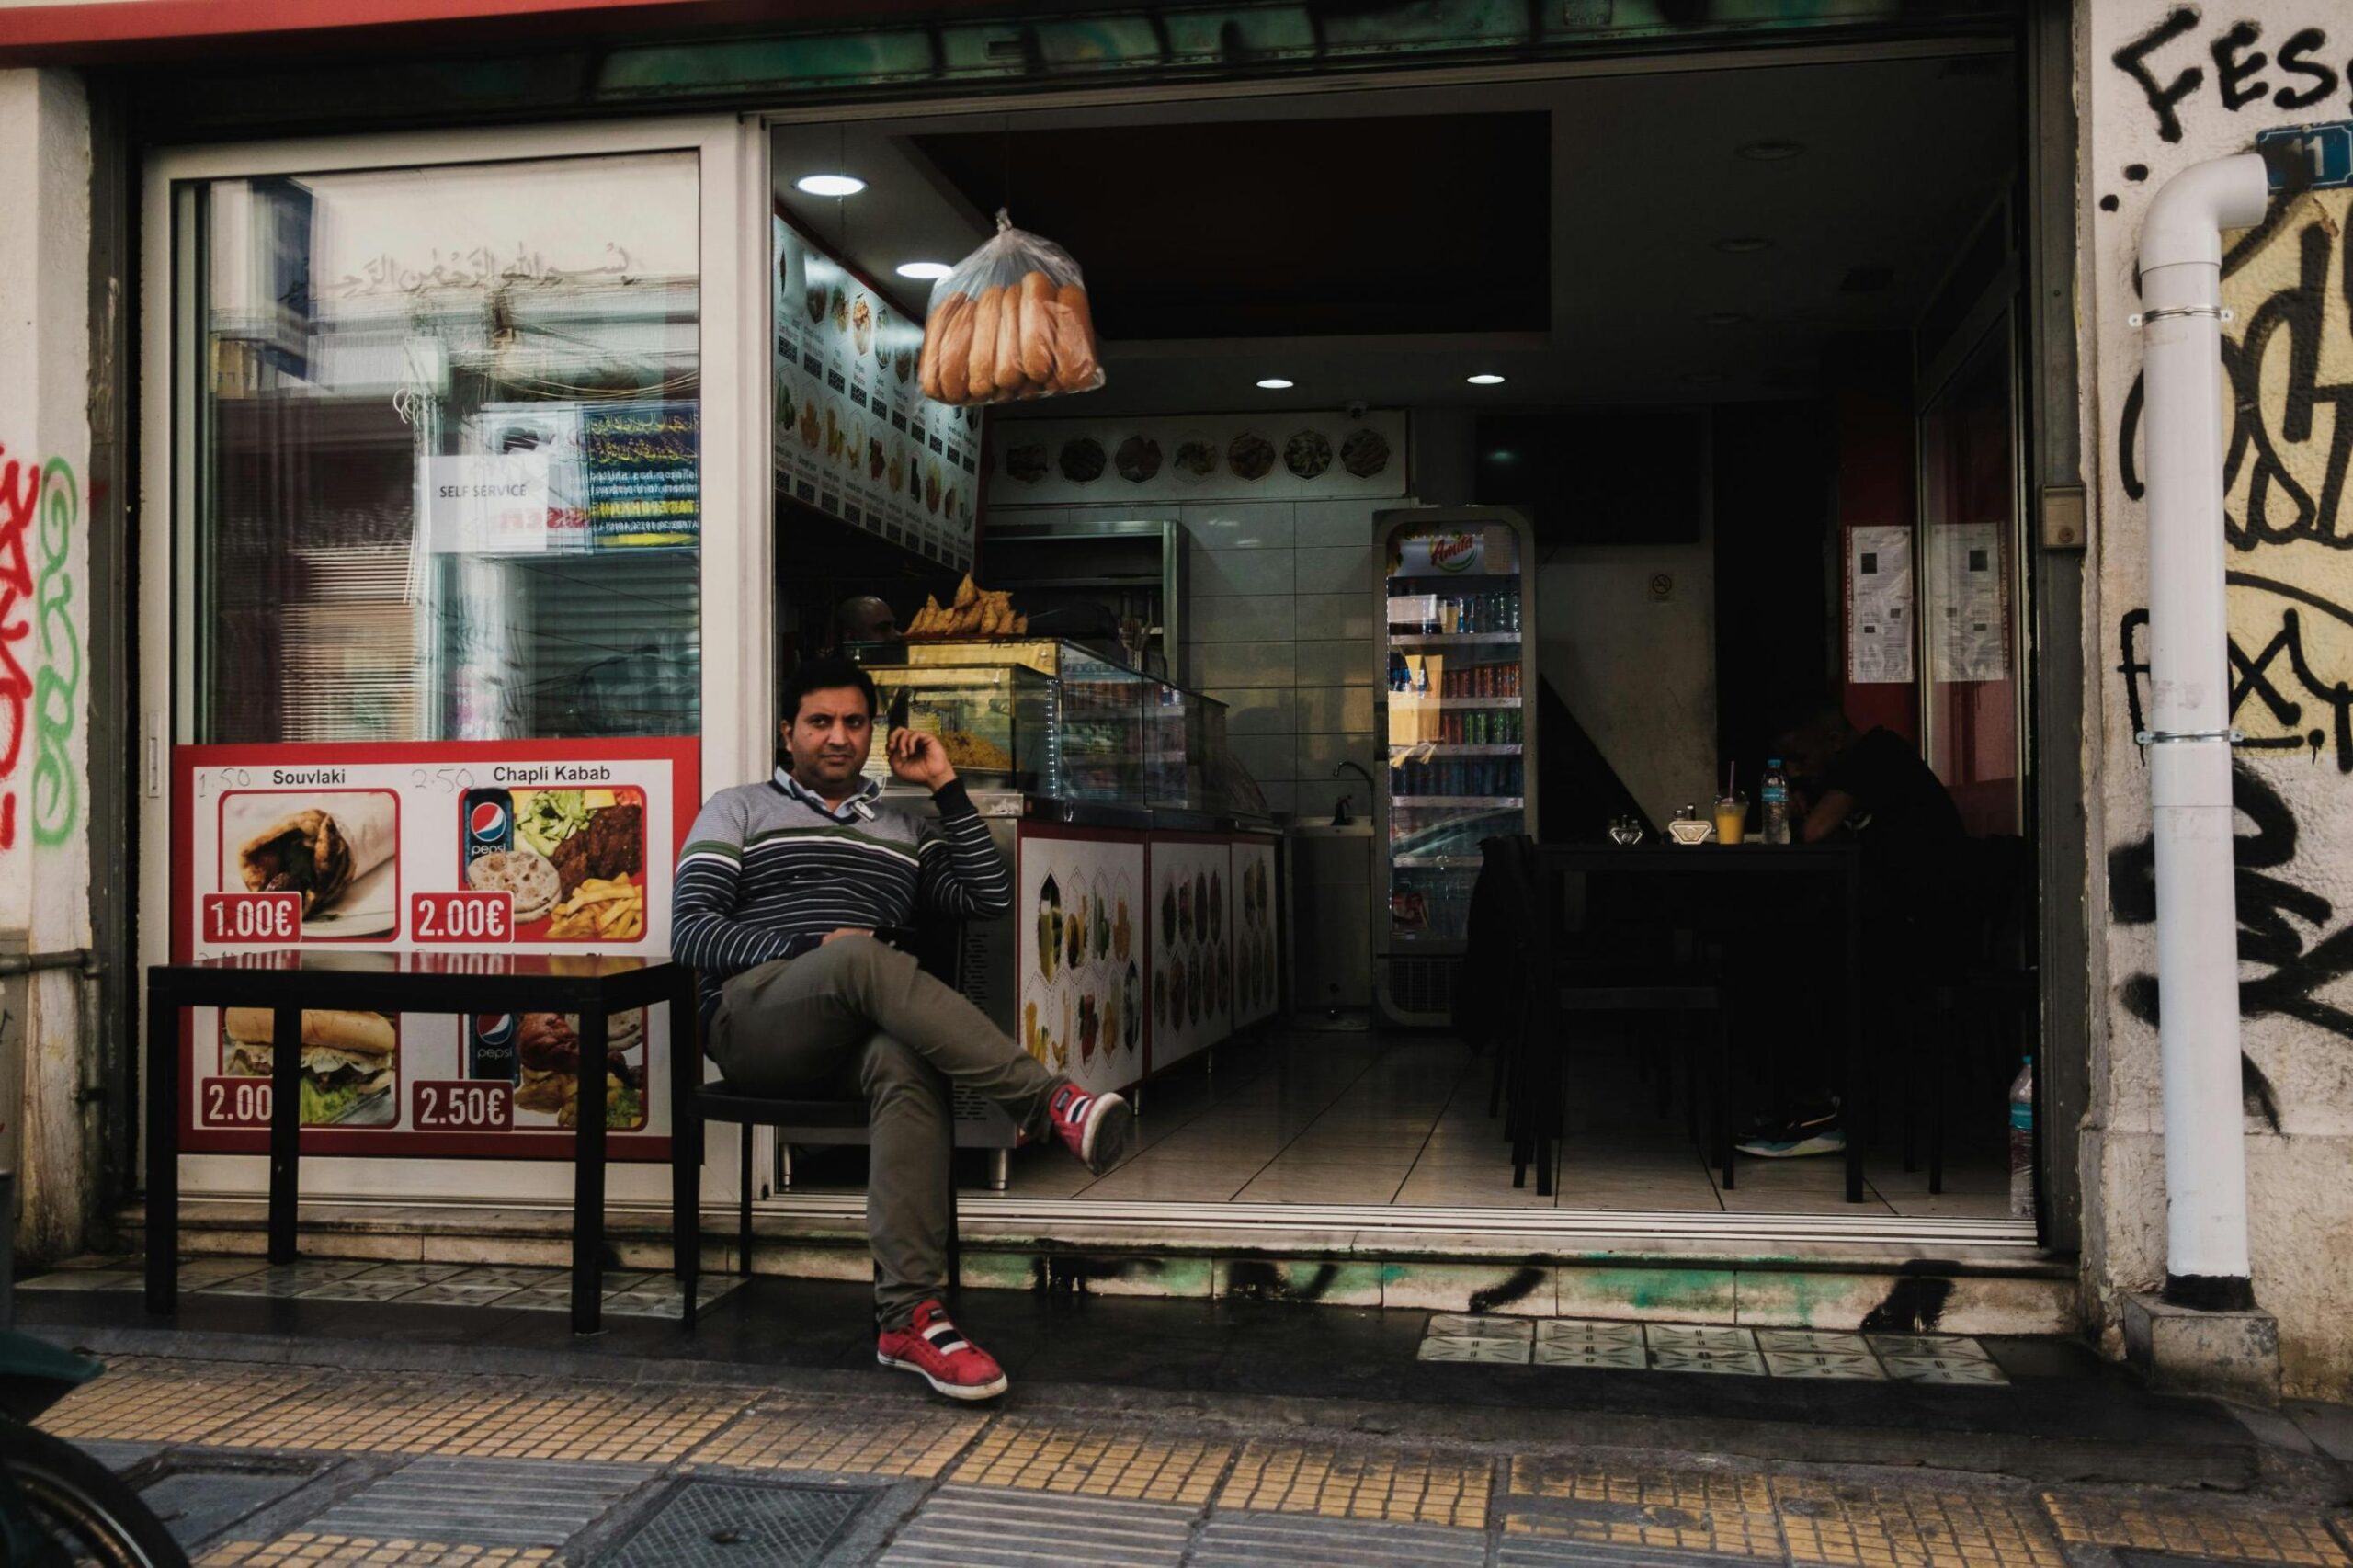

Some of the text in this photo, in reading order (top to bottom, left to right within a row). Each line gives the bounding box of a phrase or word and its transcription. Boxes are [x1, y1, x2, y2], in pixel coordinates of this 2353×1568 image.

[2111, 4, 2353, 143] FES
[439, 483, 528, 499] SELF SERVICE
[1430, 533, 1473, 566] Amita
[272, 769, 347, 786] Souvlaki
[412, 768, 475, 793] 2.50
[494, 765, 611, 785] Chapli Kabab
[472, 843, 506, 856] pepsi
[210, 898, 293, 937] 1.00€
[417, 898, 506, 937] 2.00€
[477, 1047, 513, 1060] pepsi
[420, 1086, 506, 1126] 2.50€
